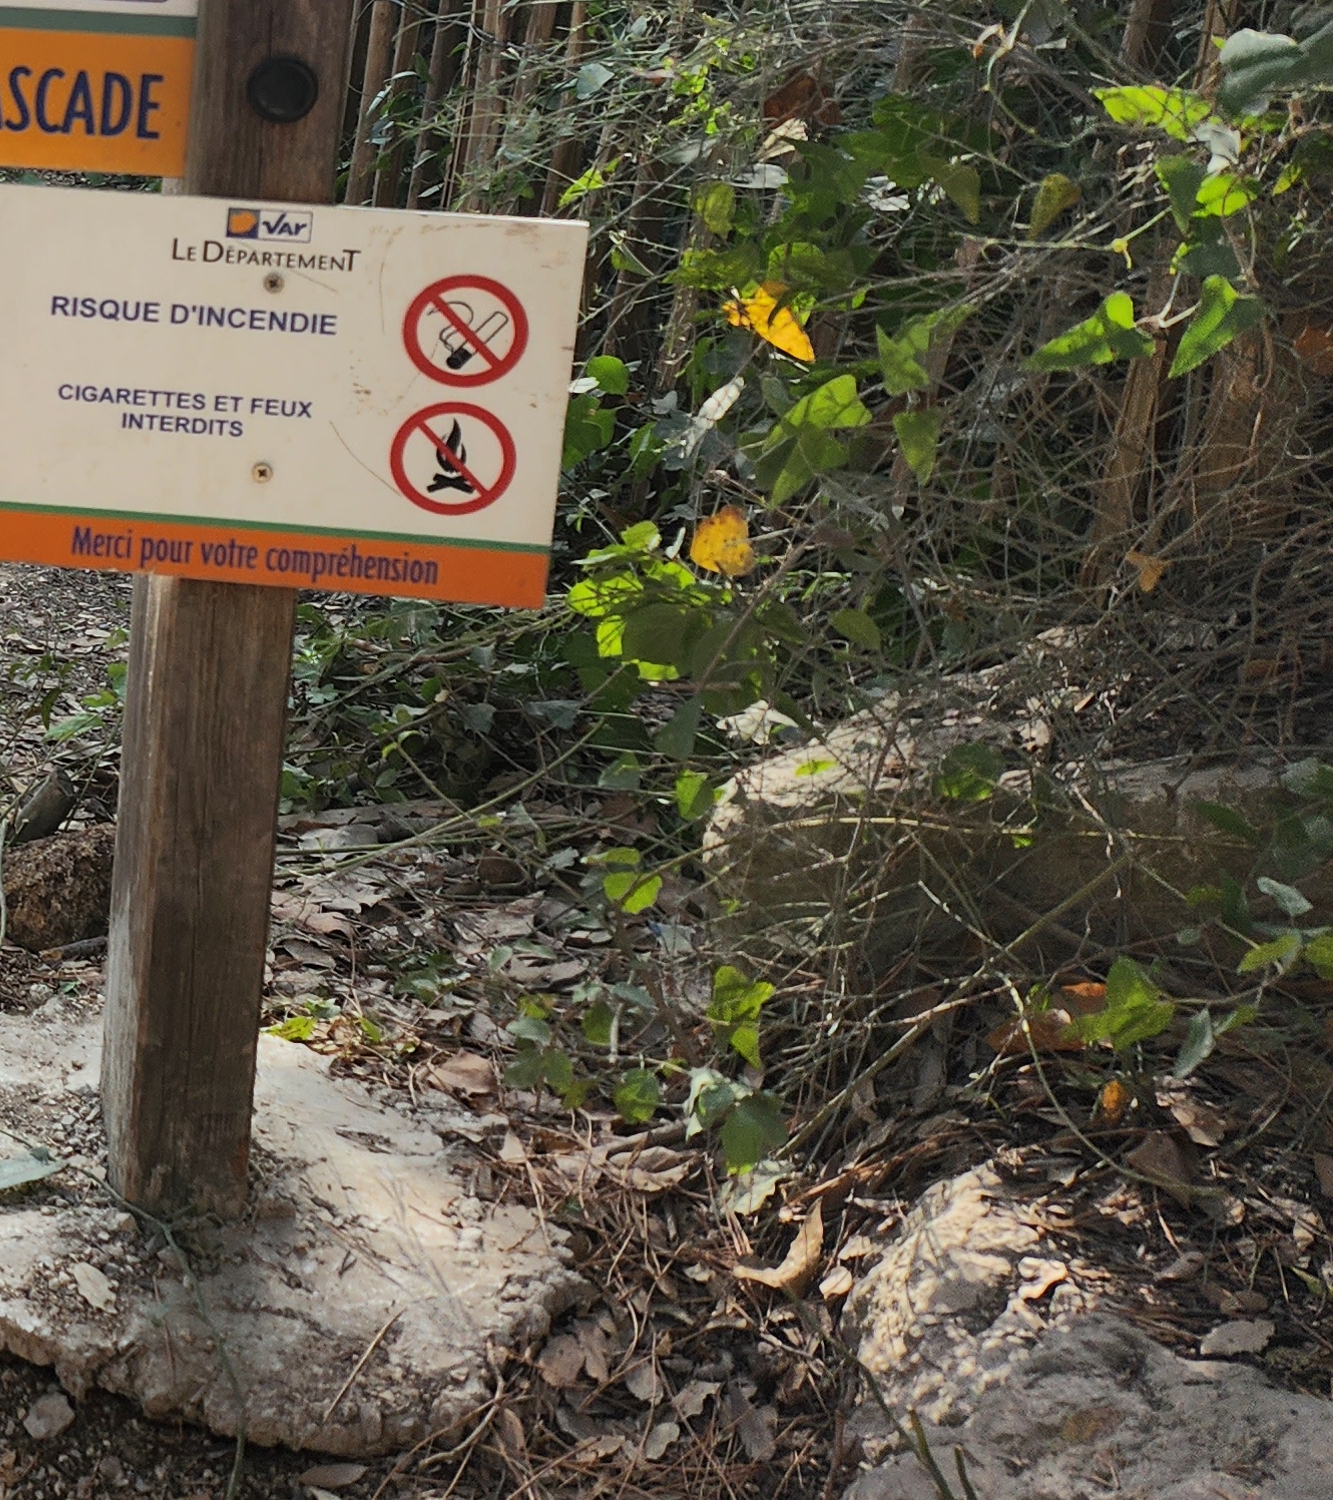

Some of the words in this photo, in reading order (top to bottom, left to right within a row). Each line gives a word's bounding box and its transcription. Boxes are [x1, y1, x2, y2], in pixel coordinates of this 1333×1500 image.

[50, 296, 160, 324] RISQUE
[170, 303, 338, 336] D'INCENDIE
[57, 384, 207, 411] CIGARETTES
[214, 395, 244, 413] ET
[250, 397, 313, 419] FEUX
[121, 413, 243, 438] INTERDITS
[71, 526, 133, 563] Merci
[139, 535, 194, 571] pour
[201, 537, 258, 569] votre
[266, 546, 439, 586] compréhension
